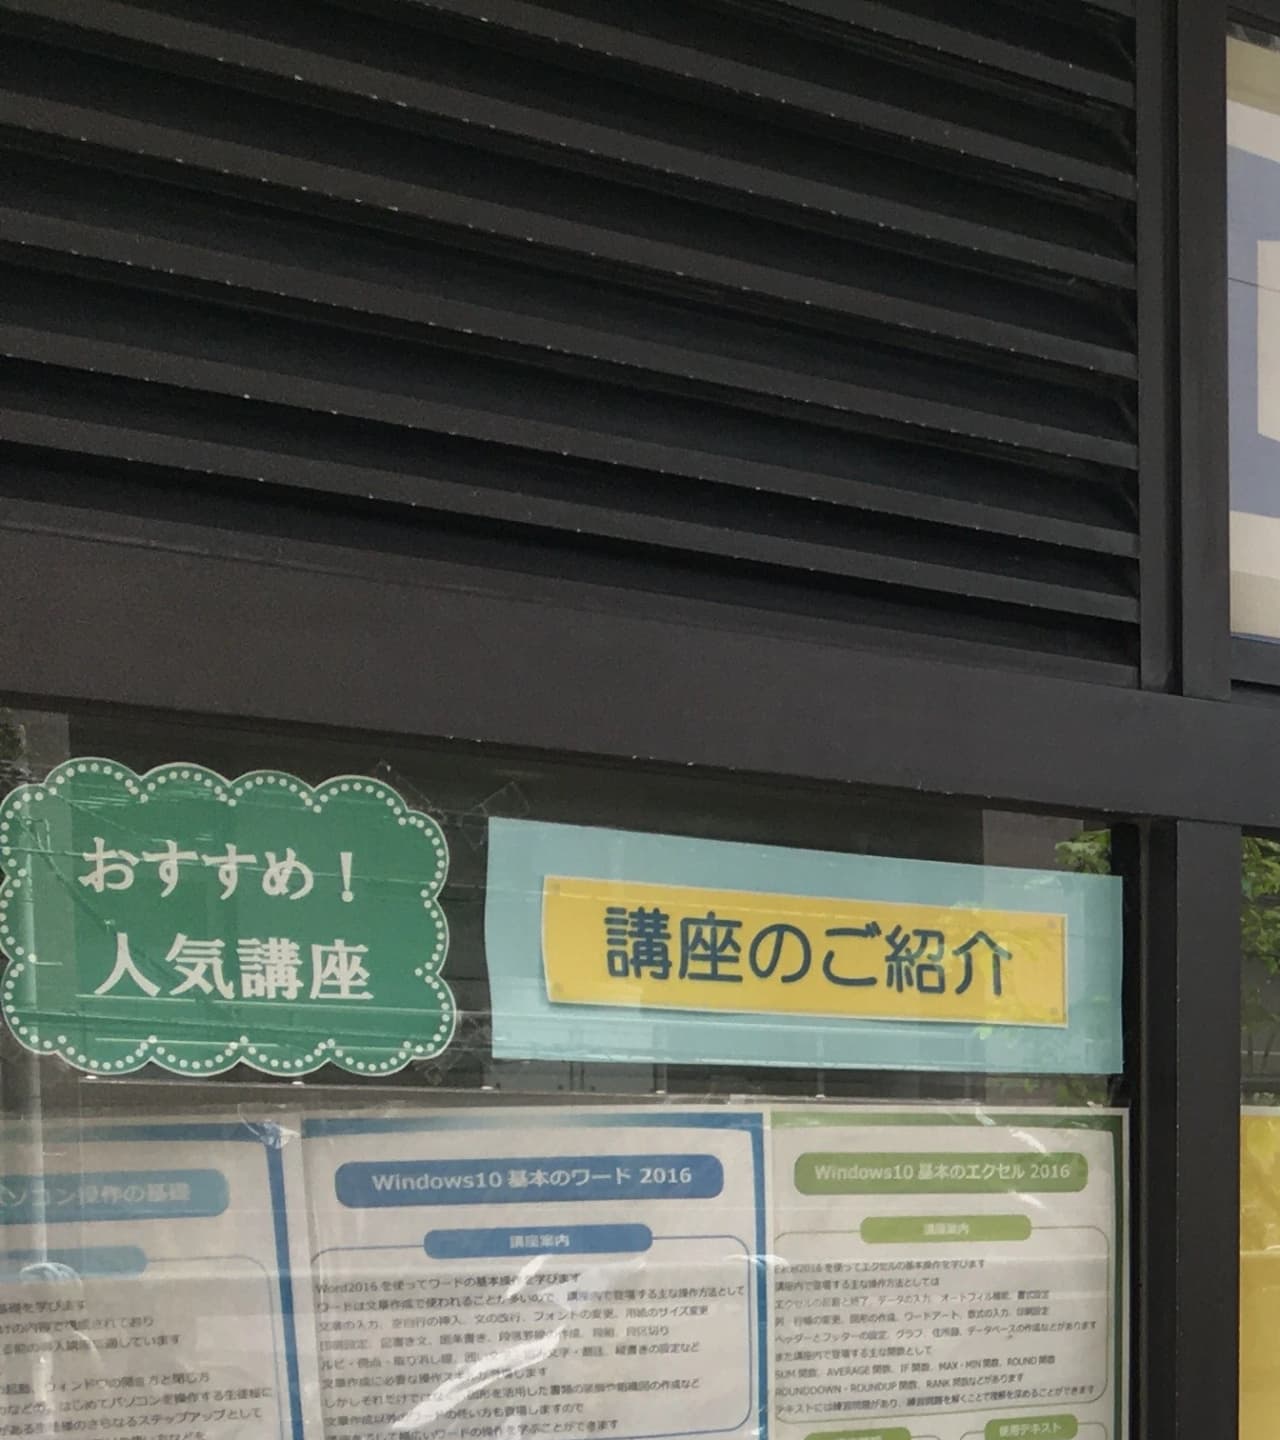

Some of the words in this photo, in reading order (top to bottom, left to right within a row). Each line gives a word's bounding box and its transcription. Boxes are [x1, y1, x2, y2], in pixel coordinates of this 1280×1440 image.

[78, 836, 359, 904] おすすめ！
[93, 939, 374, 1002] 人気講座
[606, 906, 1013, 996] 講座のご紹介
[373, 1172, 501, 1192] Windows10
[507, 1169, 631, 1188] 基本のワード
[640, 1167, 692, 1185] 2016
[814, 1165, 914, 1180] Windows10
[917, 1163, 1024, 1180] 基本のエクセル
[1030, 1163, 1070, 1178] 2016
